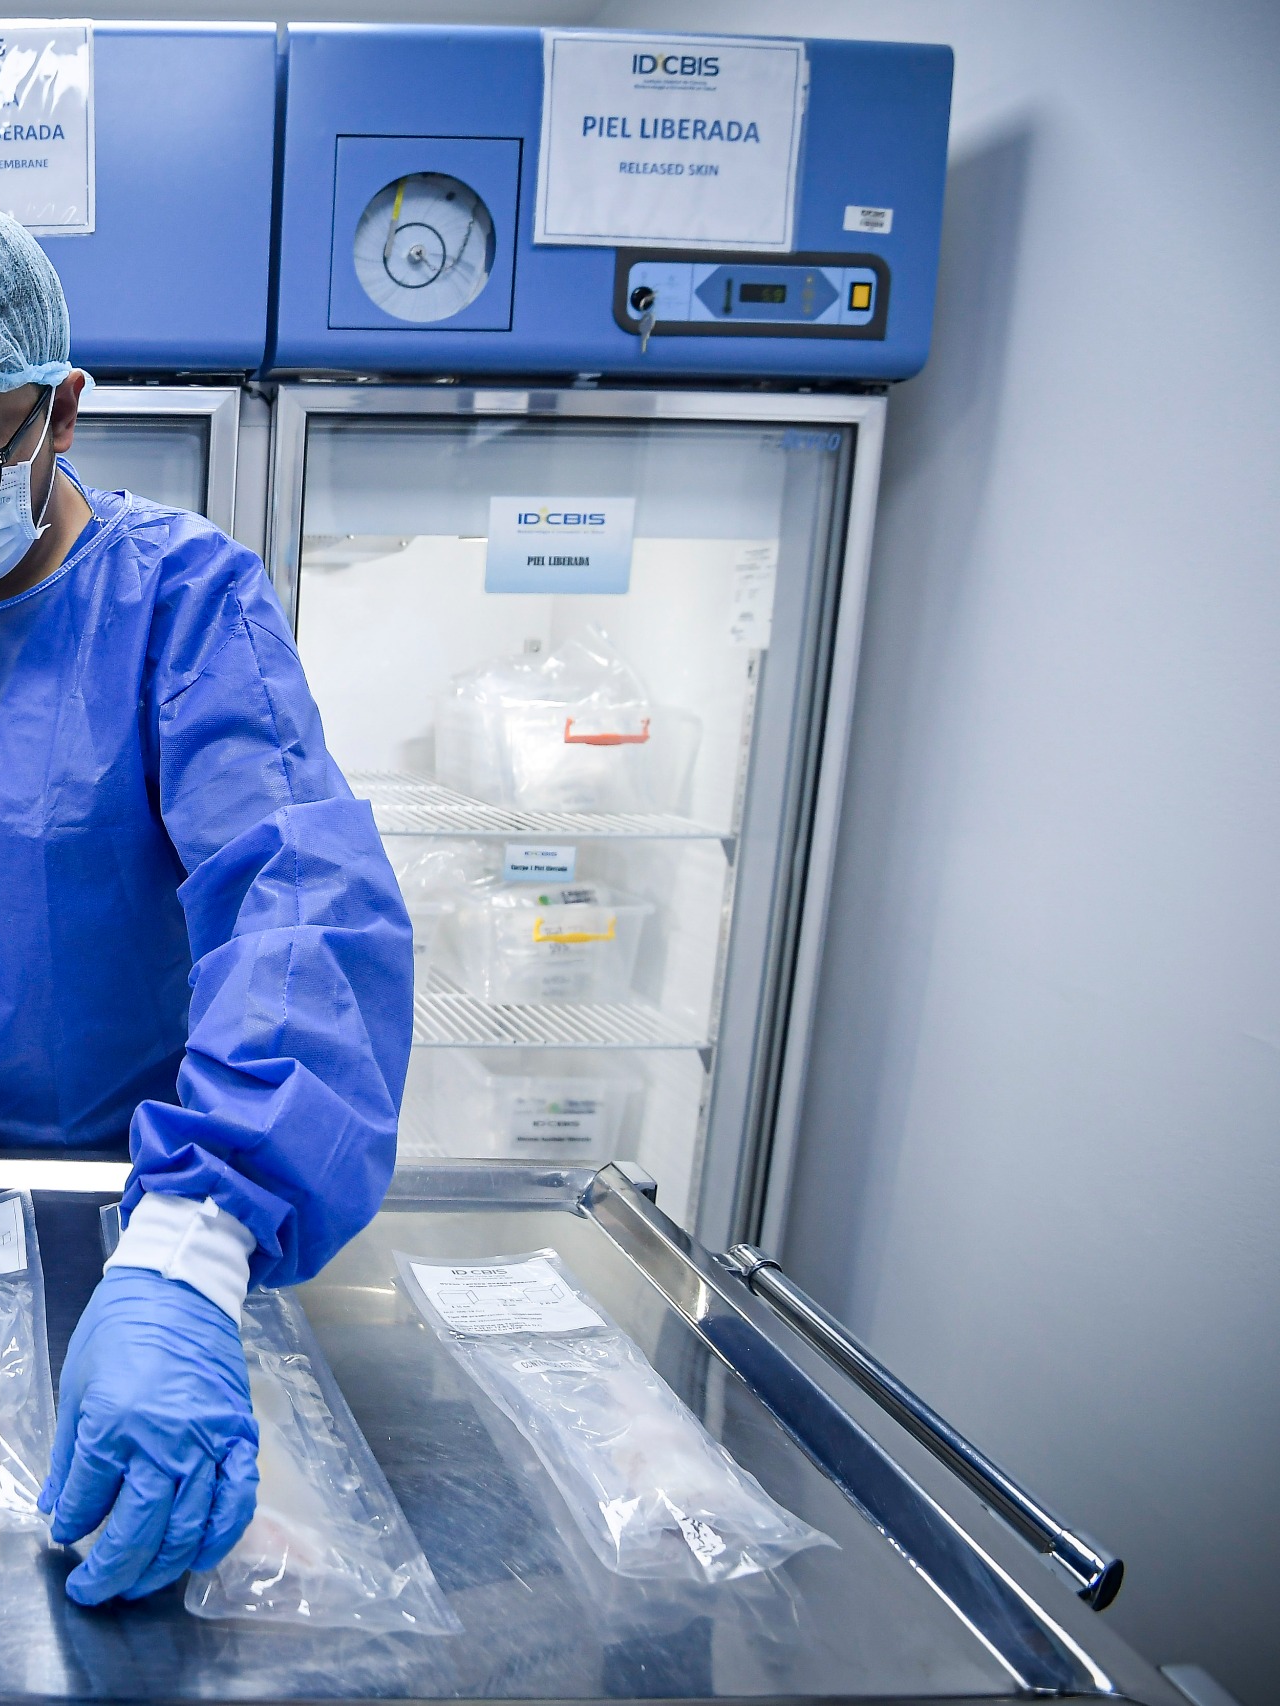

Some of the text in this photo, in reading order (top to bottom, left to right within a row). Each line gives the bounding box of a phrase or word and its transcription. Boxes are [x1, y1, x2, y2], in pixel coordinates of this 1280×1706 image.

[582, 115, 760, 144] PIEL LIBERADA
[619, 161, 720, 177] RELEASED SKIN
[548, 555, 590, 567] LIBERADA
